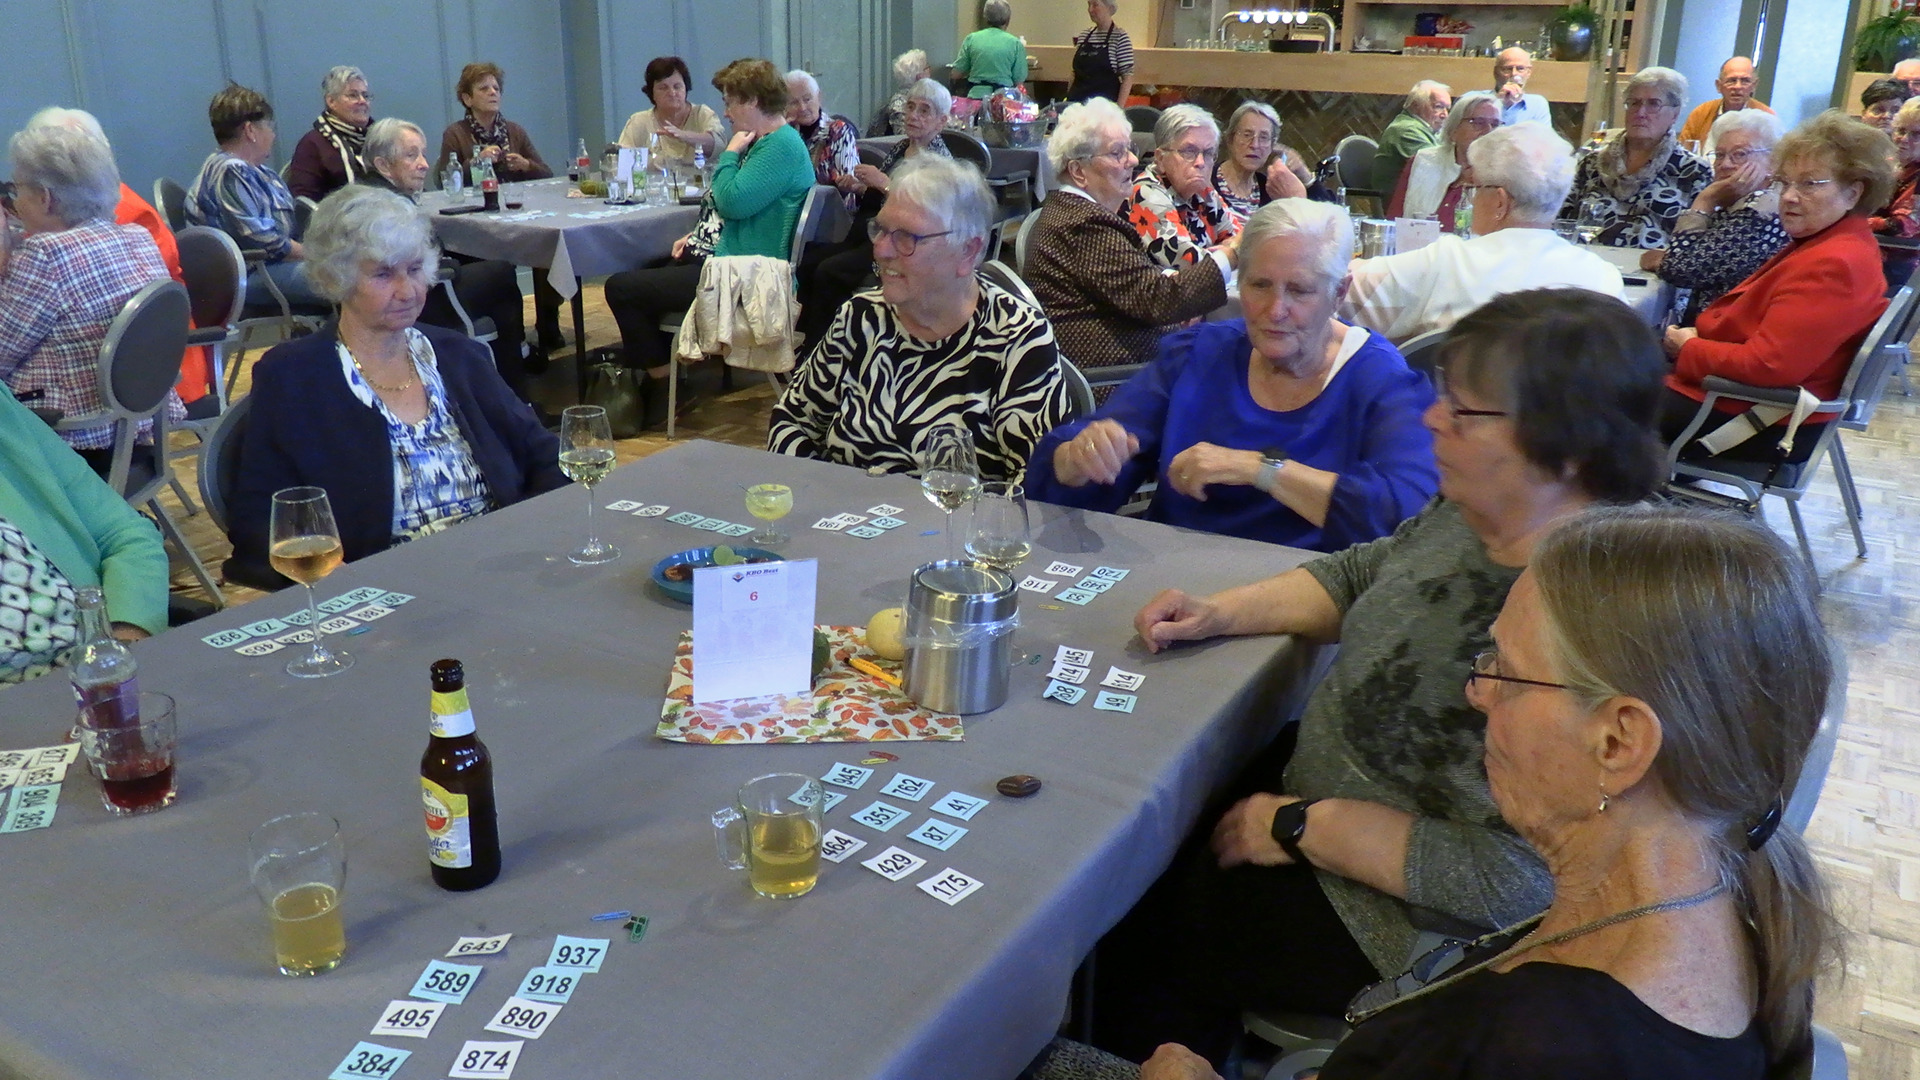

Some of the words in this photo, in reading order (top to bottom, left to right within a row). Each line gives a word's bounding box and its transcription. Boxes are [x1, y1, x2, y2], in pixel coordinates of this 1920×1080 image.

[819, 521, 840, 529] 190
[1098, 568, 1124, 579] 720
[1024, 580, 1050, 590] 116
[1081, 580, 1109, 591] 349
[750, 591, 758, 601] 6
[1066, 592, 1086, 602] 53
[256, 622, 278, 634] 79
[210, 631, 242, 646] 993
[1105, 697, 1126, 707] 49
[833, 767, 862, 785] 945
[893, 778, 924, 797] 762
[953, 798, 973, 812] 41
[863, 807, 898, 826] 351
[922, 826, 949, 842] 87
[822, 834, 853, 857] 464
[877, 853, 912, 875] 429
[932, 874, 969, 896] 175
[458, 940, 501, 953] 643
[556, 945, 601, 966] 937
[425, 969, 470, 993] 589
[527, 974, 572, 994] 918
[387, 1008, 434, 1028] 495
[500, 1006, 547, 1030] 890
[347, 1051, 398, 1076] 384
[462, 1050, 509, 1070] 874
